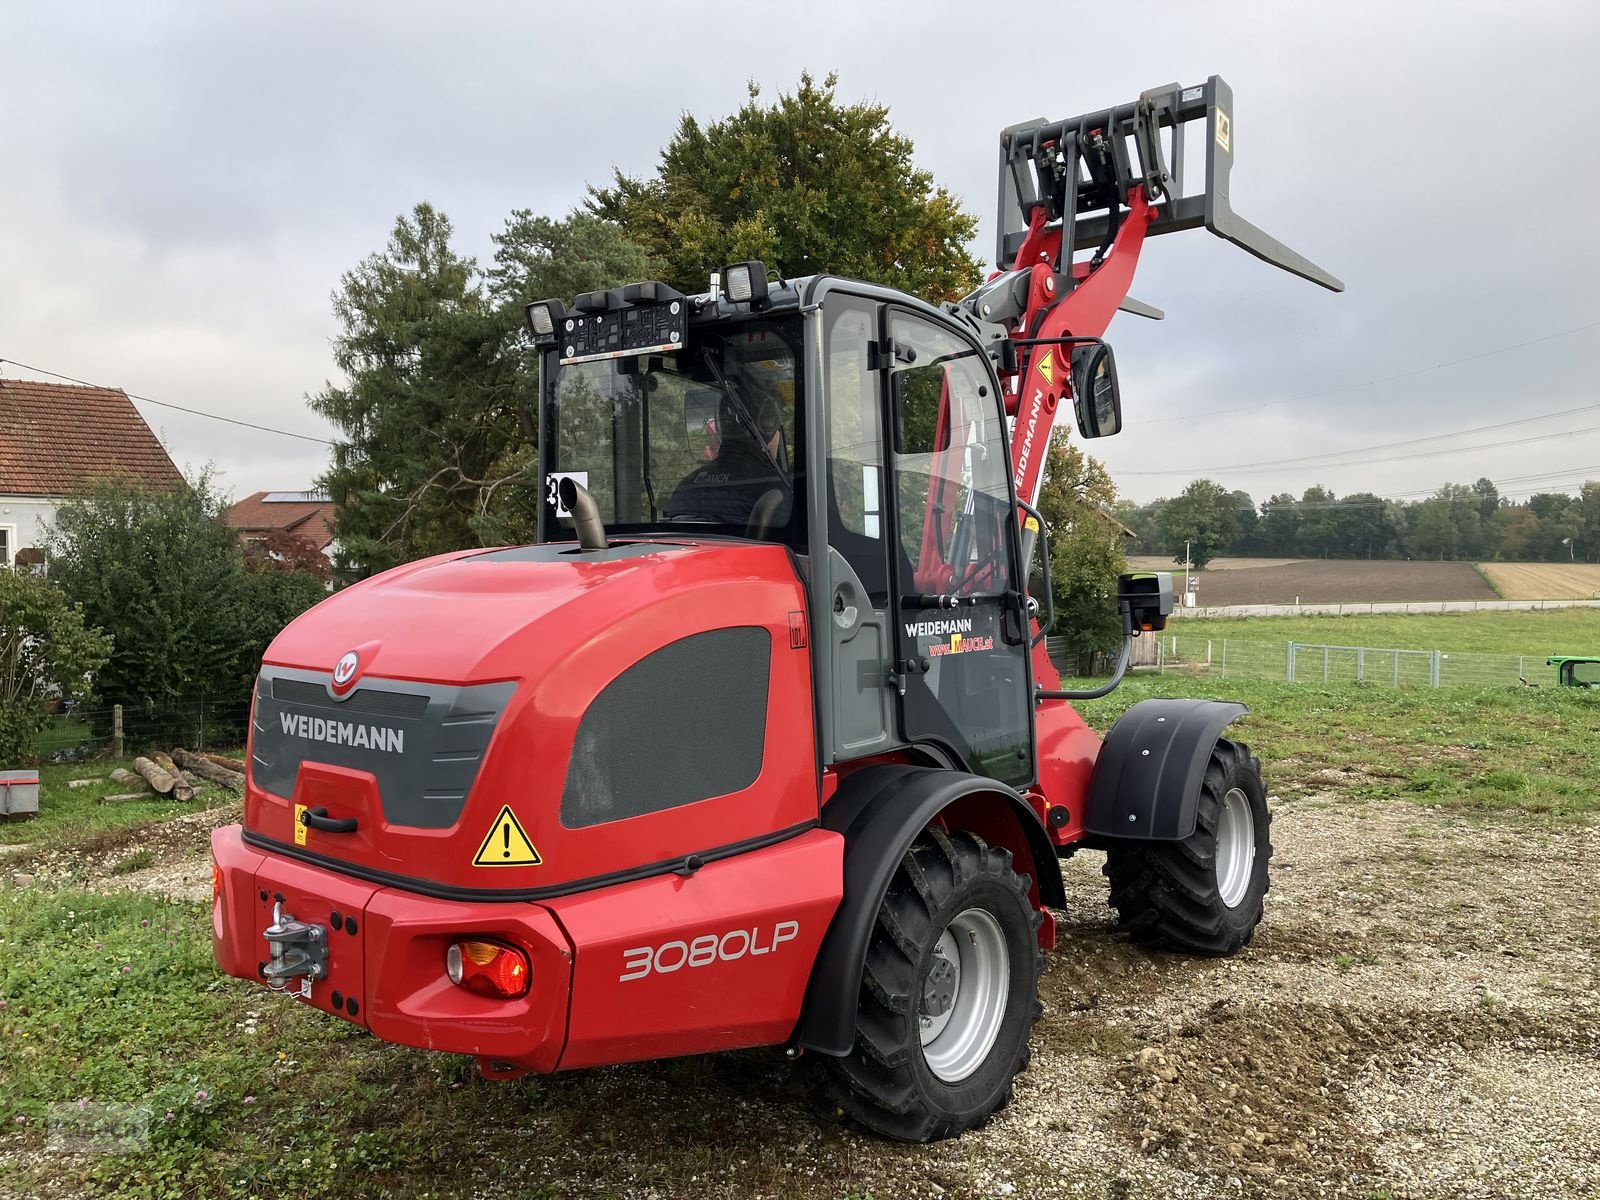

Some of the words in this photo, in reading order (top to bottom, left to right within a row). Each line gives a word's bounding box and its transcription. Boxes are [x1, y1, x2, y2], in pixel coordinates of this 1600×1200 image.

[1015, 388, 1043, 492] EIDEMANN
[905, 618, 972, 637] WEIDEMANN
[279, 711, 404, 754] WEIDEMANN
[619, 920, 799, 982] 3080LP
